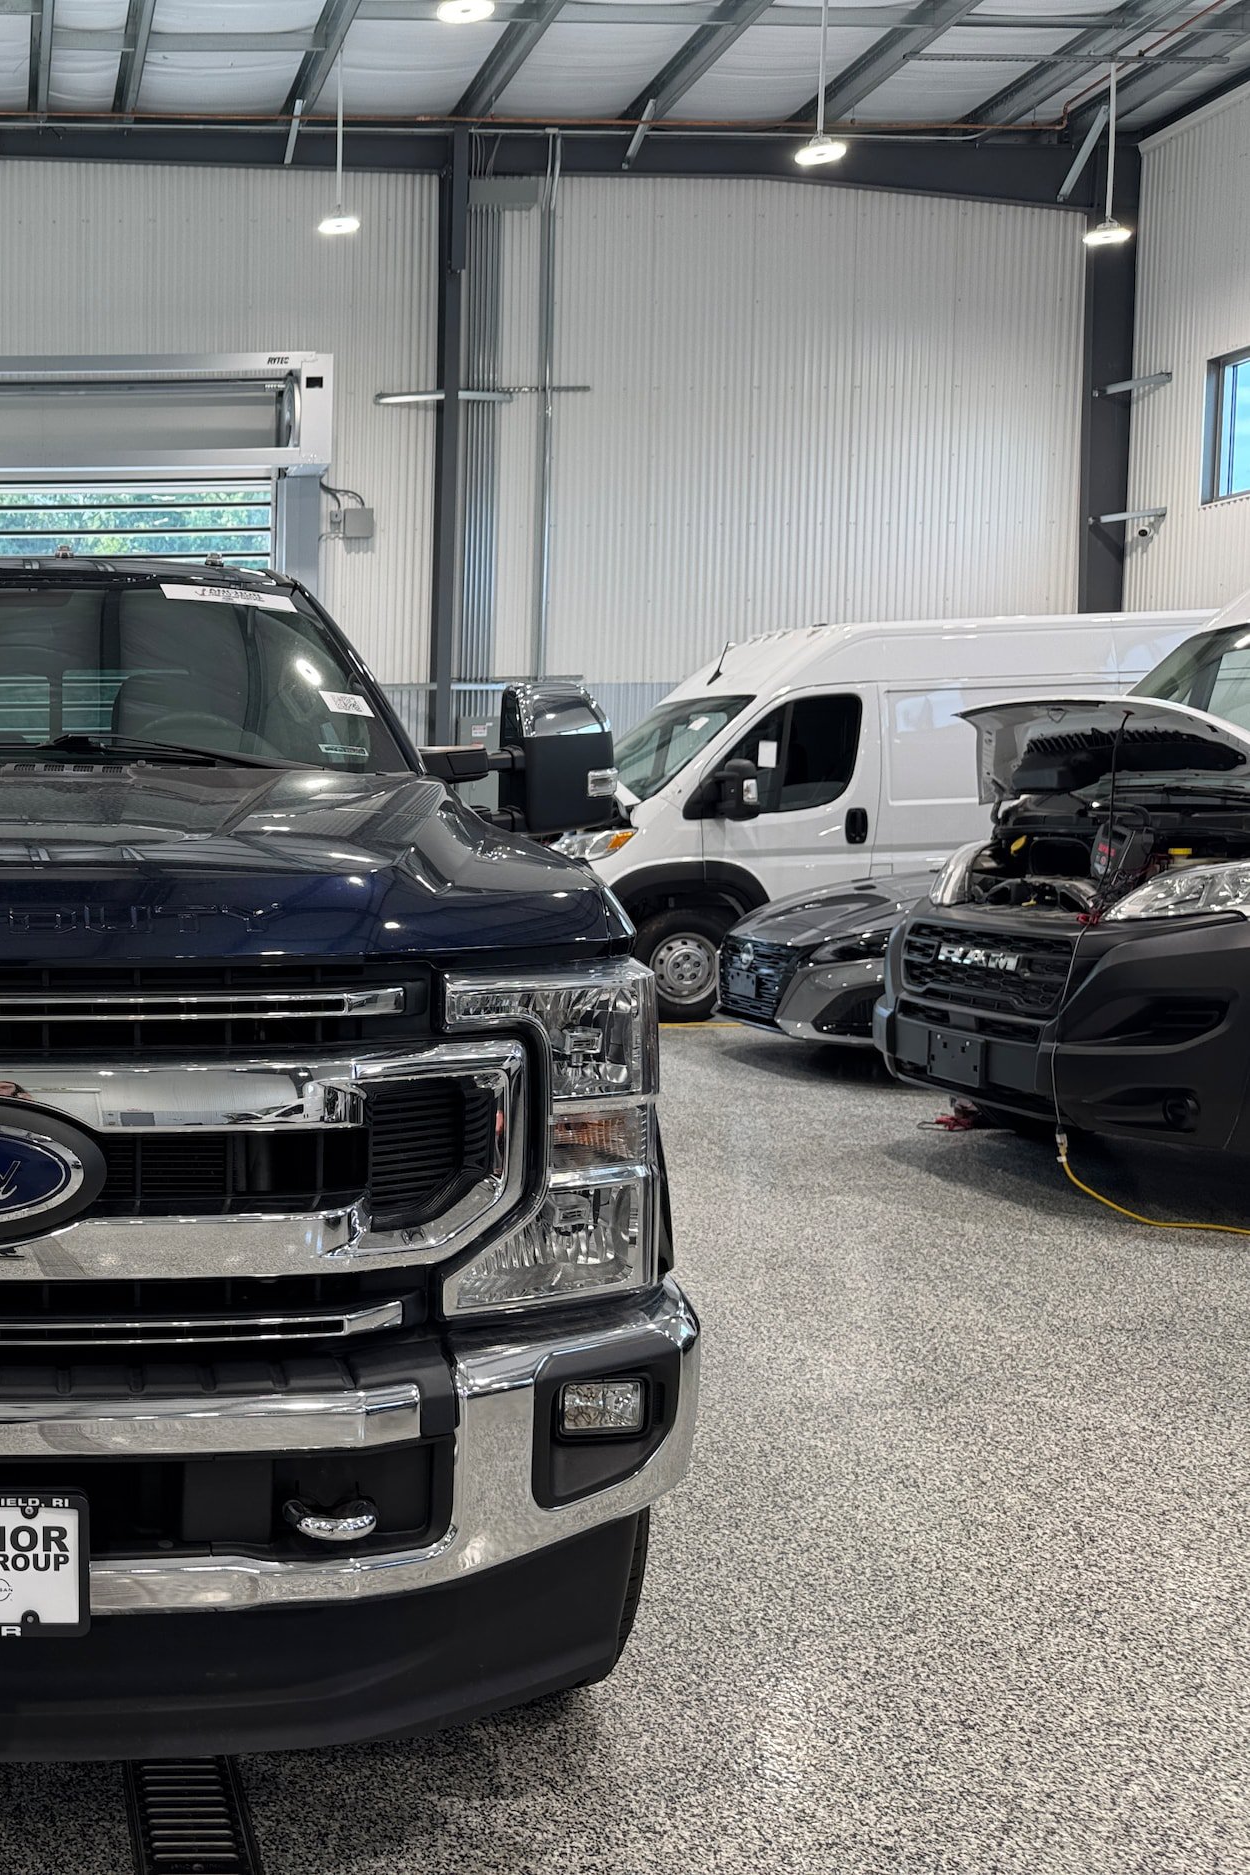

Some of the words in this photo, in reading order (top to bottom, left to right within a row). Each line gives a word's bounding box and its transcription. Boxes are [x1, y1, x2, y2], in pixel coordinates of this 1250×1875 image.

[8, 902, 282, 934] DUTY
[938, 946, 1021, 972] RAM
[52, 1498, 69, 1507] RI
